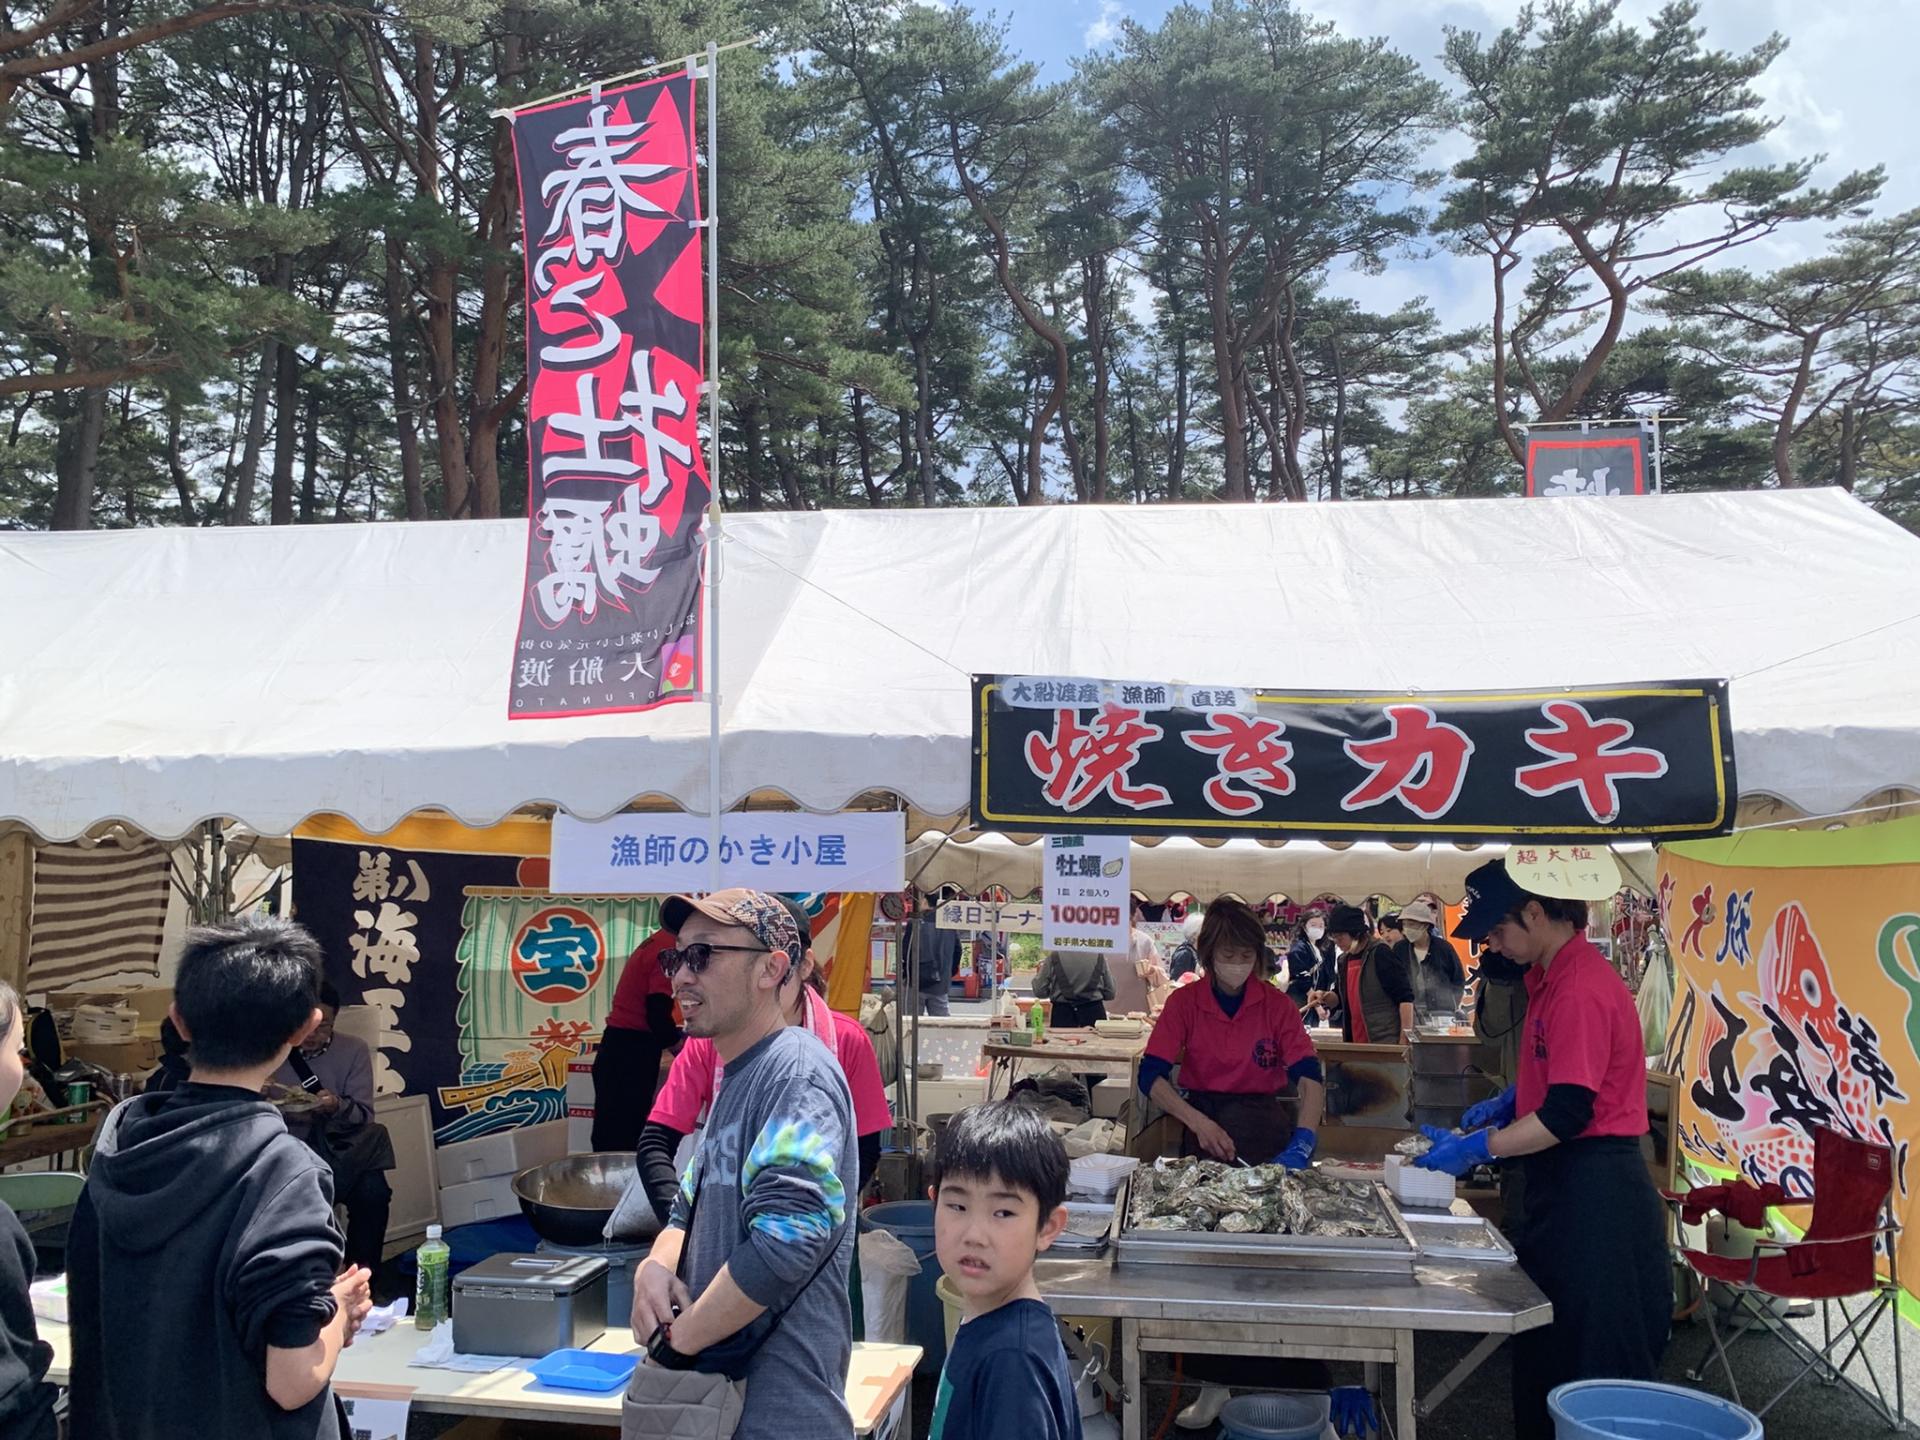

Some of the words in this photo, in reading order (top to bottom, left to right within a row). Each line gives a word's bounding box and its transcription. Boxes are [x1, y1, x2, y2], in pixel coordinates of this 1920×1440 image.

[1011, 681, 1100, 703] 大船渡産
[1122, 685, 1166, 704] 漁師
[1191, 690, 1236, 708] 直送
[1025, 700, 1668, 823] 焼きカキ
[610, 833, 847, 866] 漁師のかき小屋
[1516, 847, 1596, 864] 超大粒
[1056, 854, 1102, 878] 牡蠣
[1051, 904, 1120, 926] 1000円
[518, 916, 600, 993] 宝
